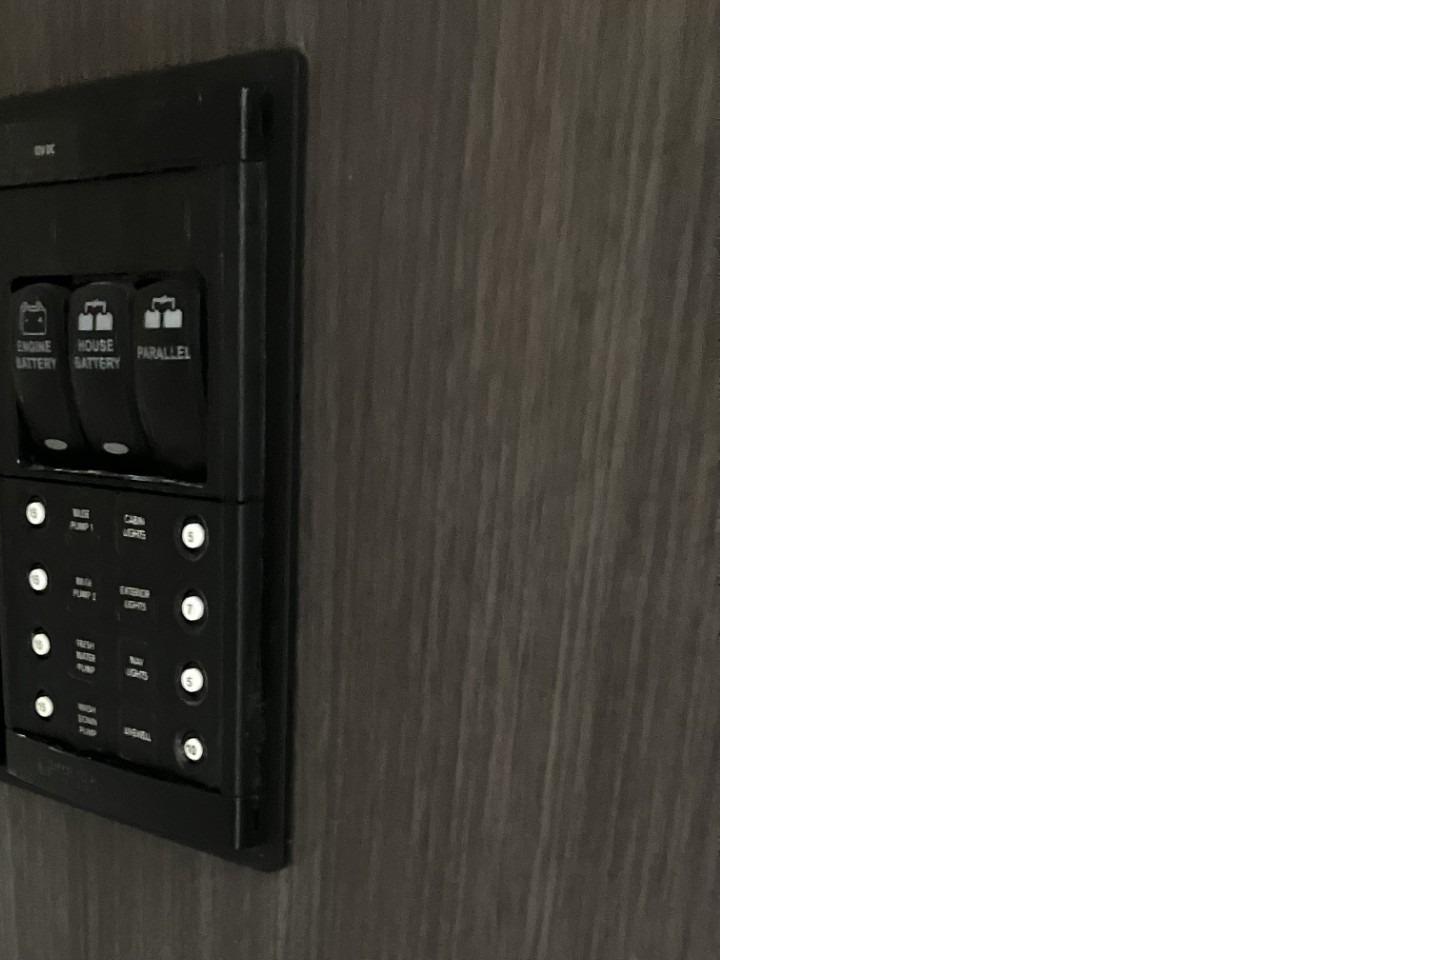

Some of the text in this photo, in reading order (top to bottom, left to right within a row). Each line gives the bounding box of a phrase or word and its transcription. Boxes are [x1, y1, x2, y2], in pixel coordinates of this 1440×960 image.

[16, 340, 52, 353] ENGINE
[77, 339, 114, 352] HOUSE
[137, 345, 191, 360] PARALLEL
[15, 357, 57, 370] BATTERY
[74, 356, 121, 370] BATTERY
